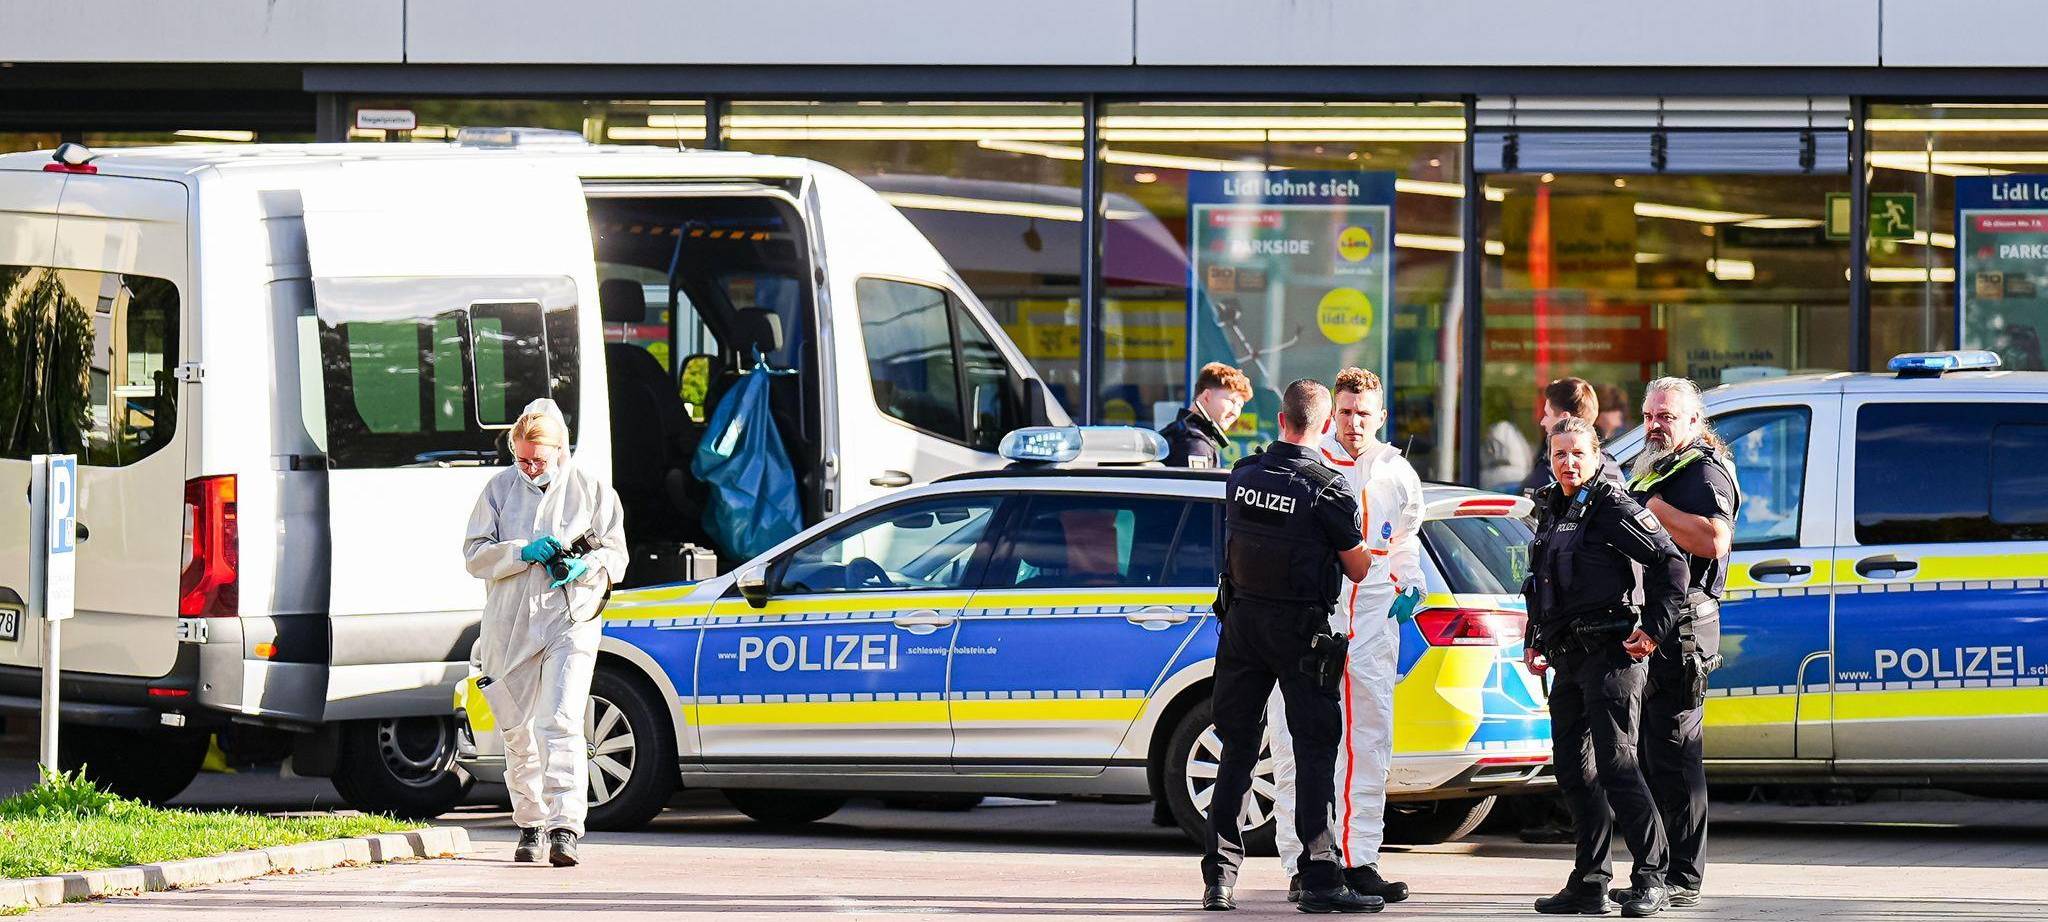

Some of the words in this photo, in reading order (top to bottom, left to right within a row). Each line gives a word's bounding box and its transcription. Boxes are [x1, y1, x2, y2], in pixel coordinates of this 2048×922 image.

[1223, 178, 1261, 197] Lidl
[1264, 178, 1316, 197] lohnt
[1320, 178, 1360, 197] sich
[1991, 182, 2029, 201] Lidl
[1232, 239, 1310, 255] PARKSIDE
[1322, 312, 1367, 326] lidl.de
[53, 465, 71, 549] P
[1234, 486, 1296, 514] POLIZEI
[1556, 523, 1578, 533] POLIZEI
[738, 634, 898, 672] POLIZEI
[1838, 671, 1872, 681] www.
[1874, 645, 2025, 680] POLIZEI
